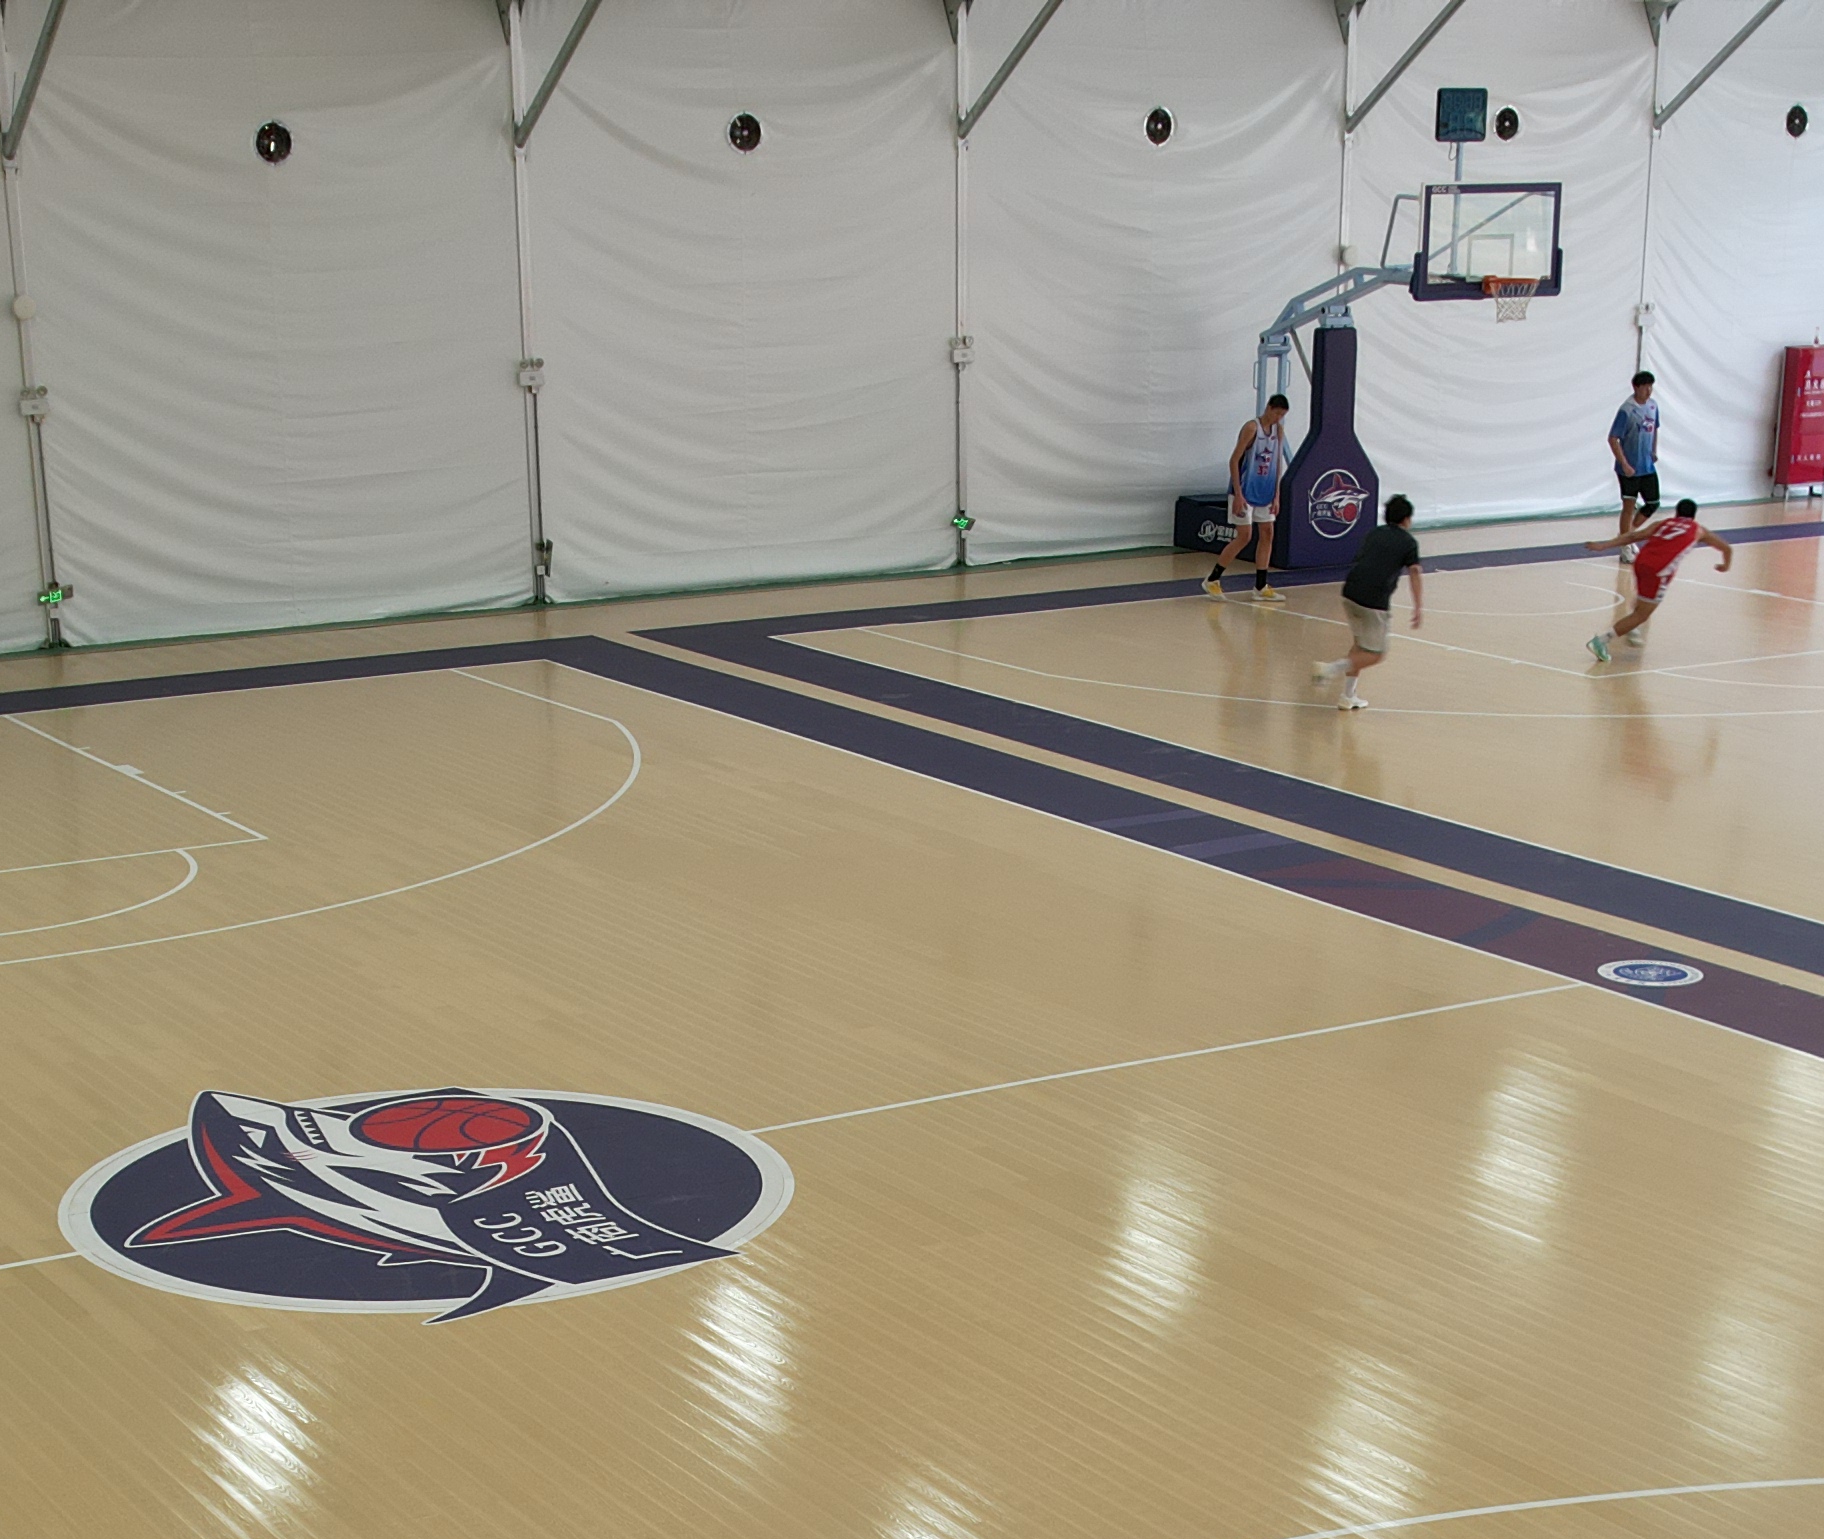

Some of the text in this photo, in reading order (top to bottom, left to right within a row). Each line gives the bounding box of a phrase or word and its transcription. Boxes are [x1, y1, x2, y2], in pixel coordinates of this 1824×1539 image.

[1653, 525, 1687, 541] 17
[474, 1212, 567, 1258] GCC
[524, 1183, 684, 1260] 广商虎鲨
